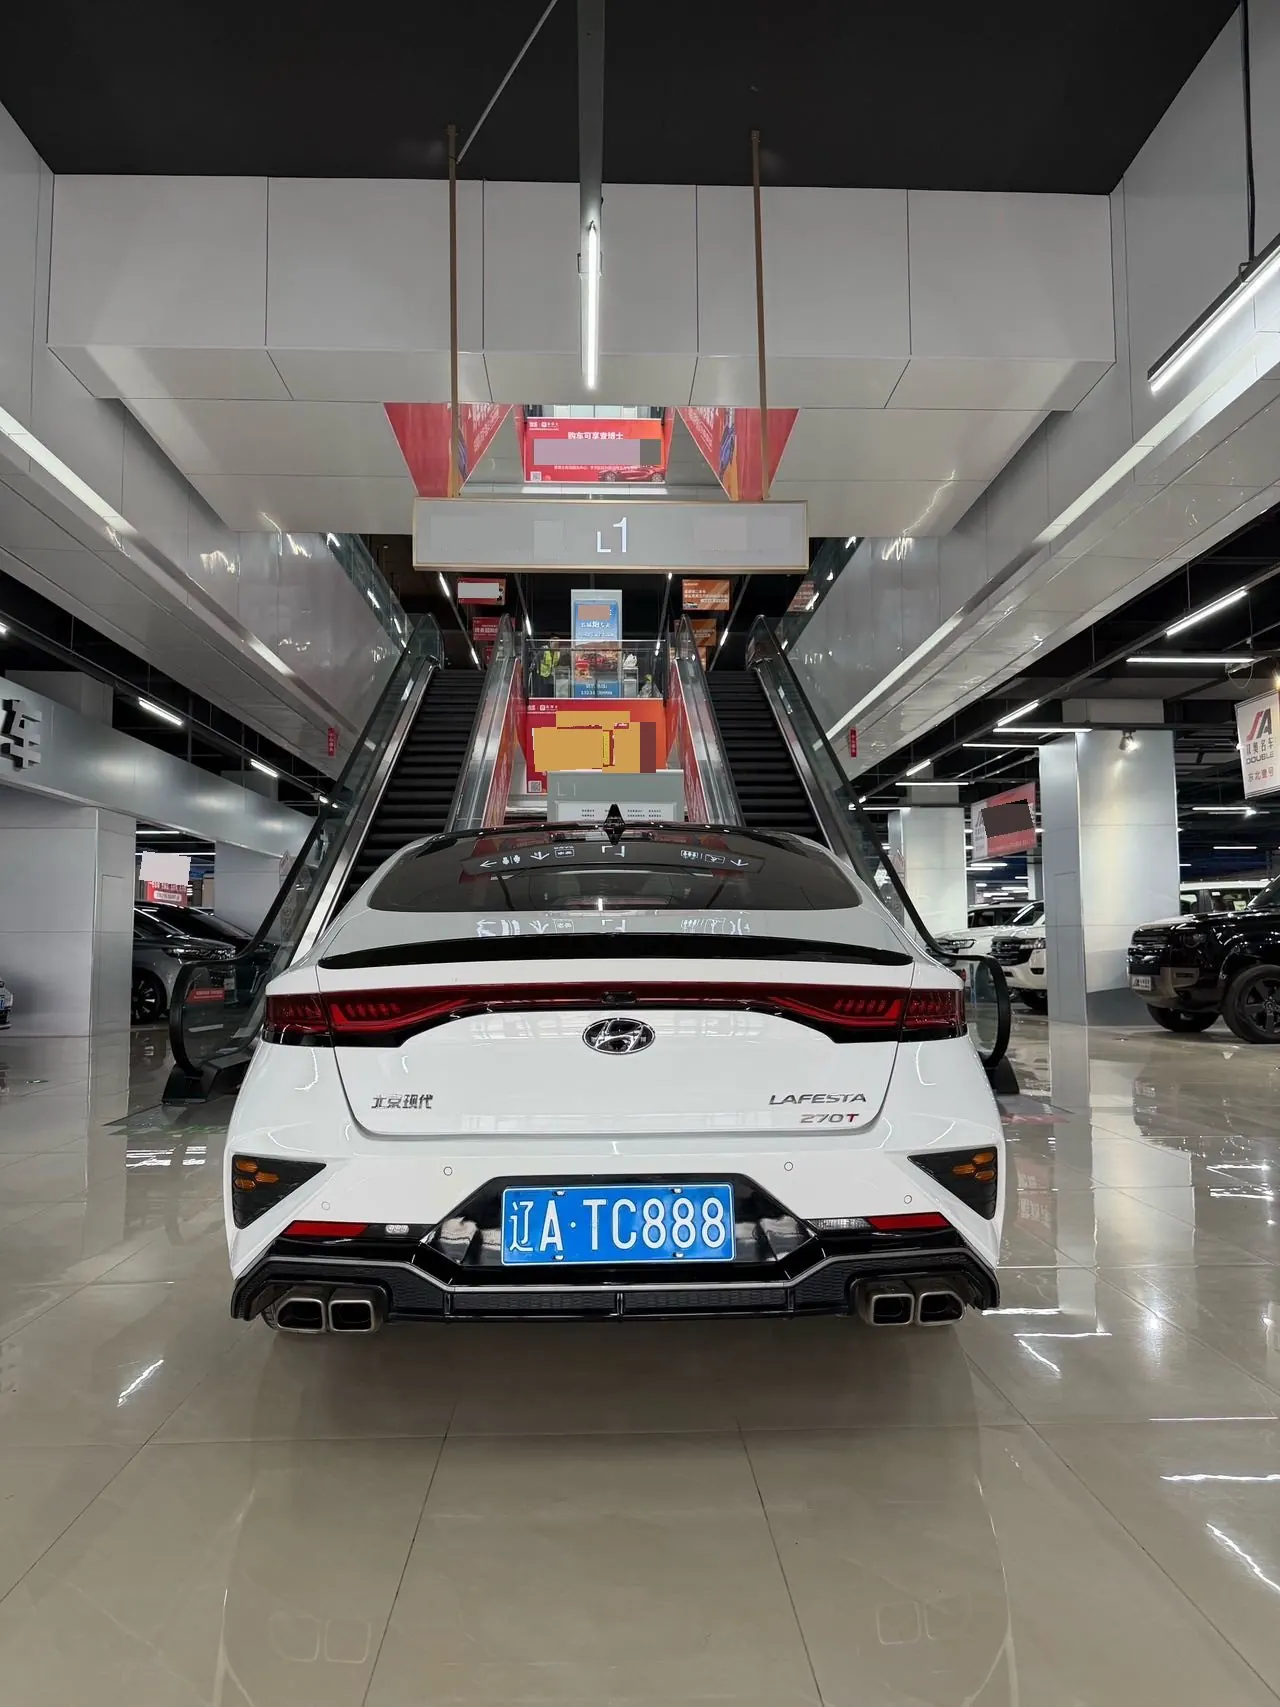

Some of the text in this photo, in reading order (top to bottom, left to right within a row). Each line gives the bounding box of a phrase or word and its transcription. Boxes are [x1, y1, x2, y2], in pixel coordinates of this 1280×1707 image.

[596, 517, 628, 553] L1
[1246, 752, 1274, 765] DOUBLE
[371, 1093, 433, 1109] 北京现代
[769, 1093, 867, 1105] LAFESTA
[800, 1113, 859, 1123] 270T
[509, 1197, 726, 1252] 辽A·TC888
